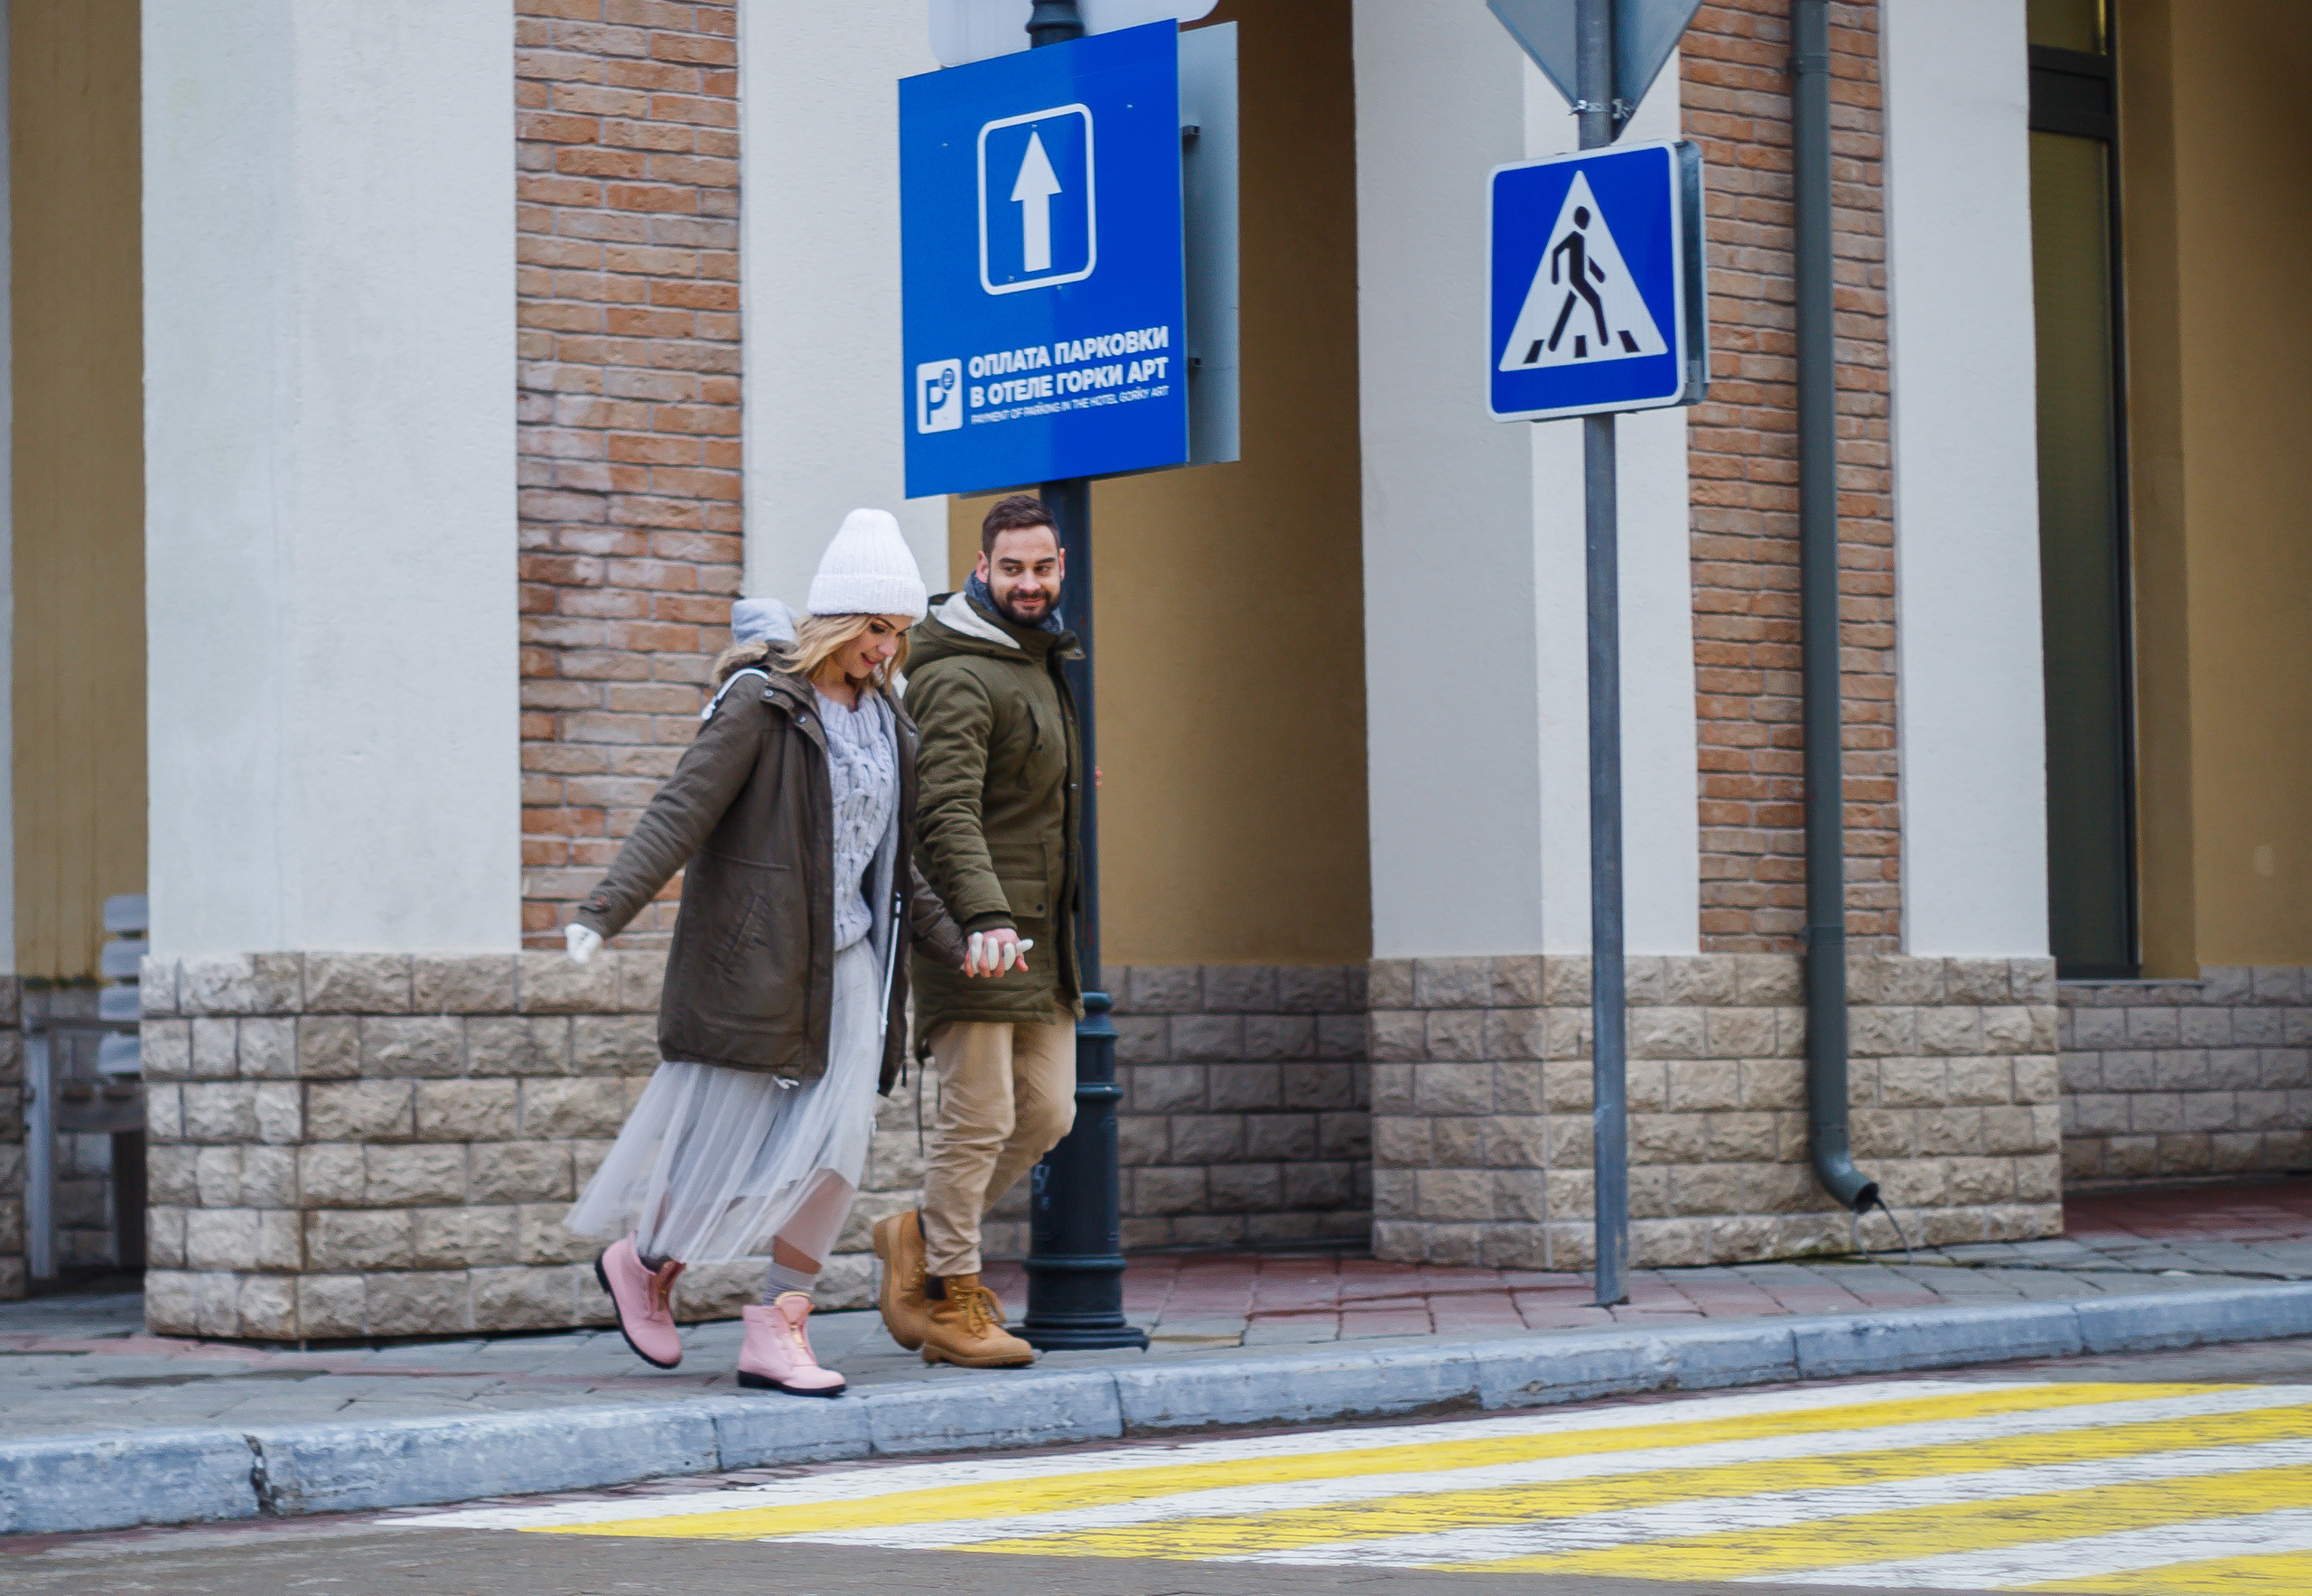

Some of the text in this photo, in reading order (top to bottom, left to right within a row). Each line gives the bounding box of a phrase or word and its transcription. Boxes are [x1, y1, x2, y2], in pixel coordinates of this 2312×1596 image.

[968, 326, 1170, 378] ОПЛАТА ПАРКОВКИ
[970, 357, 1170, 408] В ОТЕЛЕ ГОРКИ АРТ
[1010, 407, 1023, 419] OF
[1072, 397, 1090, 409] THE
